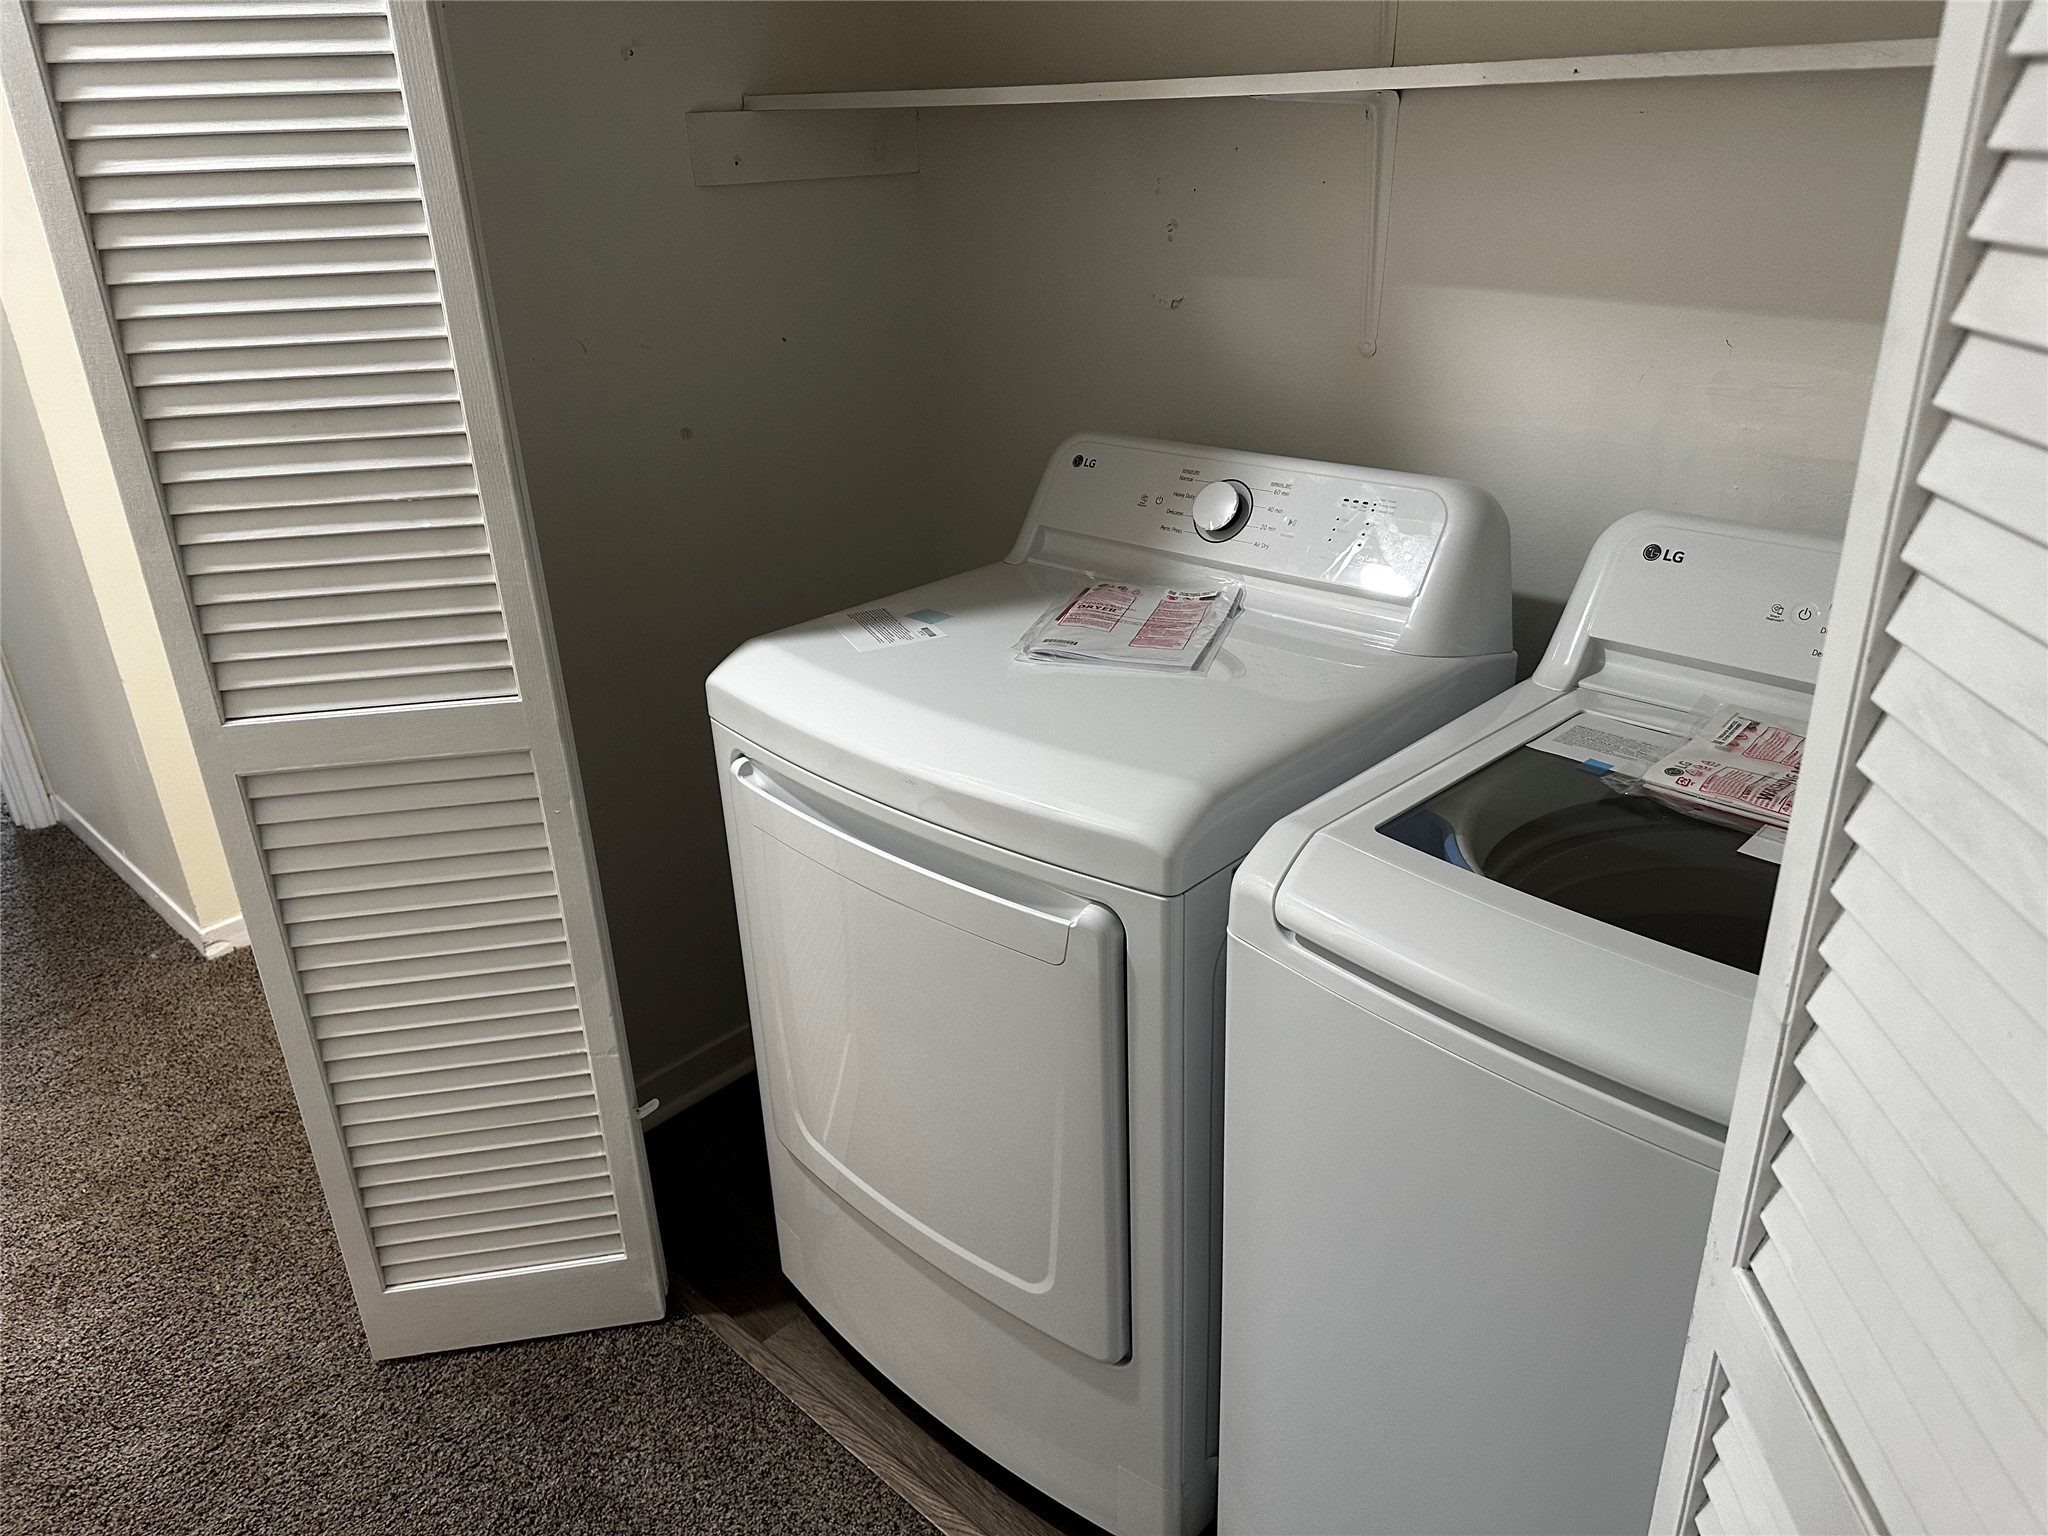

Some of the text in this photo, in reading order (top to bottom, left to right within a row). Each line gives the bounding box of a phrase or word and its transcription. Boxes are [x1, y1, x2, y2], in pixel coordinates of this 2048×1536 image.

[1083, 457, 1097, 468] LG
[1173, 491, 1196, 501] Heavy Duty
[1171, 526, 1183, 534] Press
[1260, 542, 1270, 551] Dry
[1662, 548, 1686, 563] LG
[1077, 603, 1118, 613] DRYER
